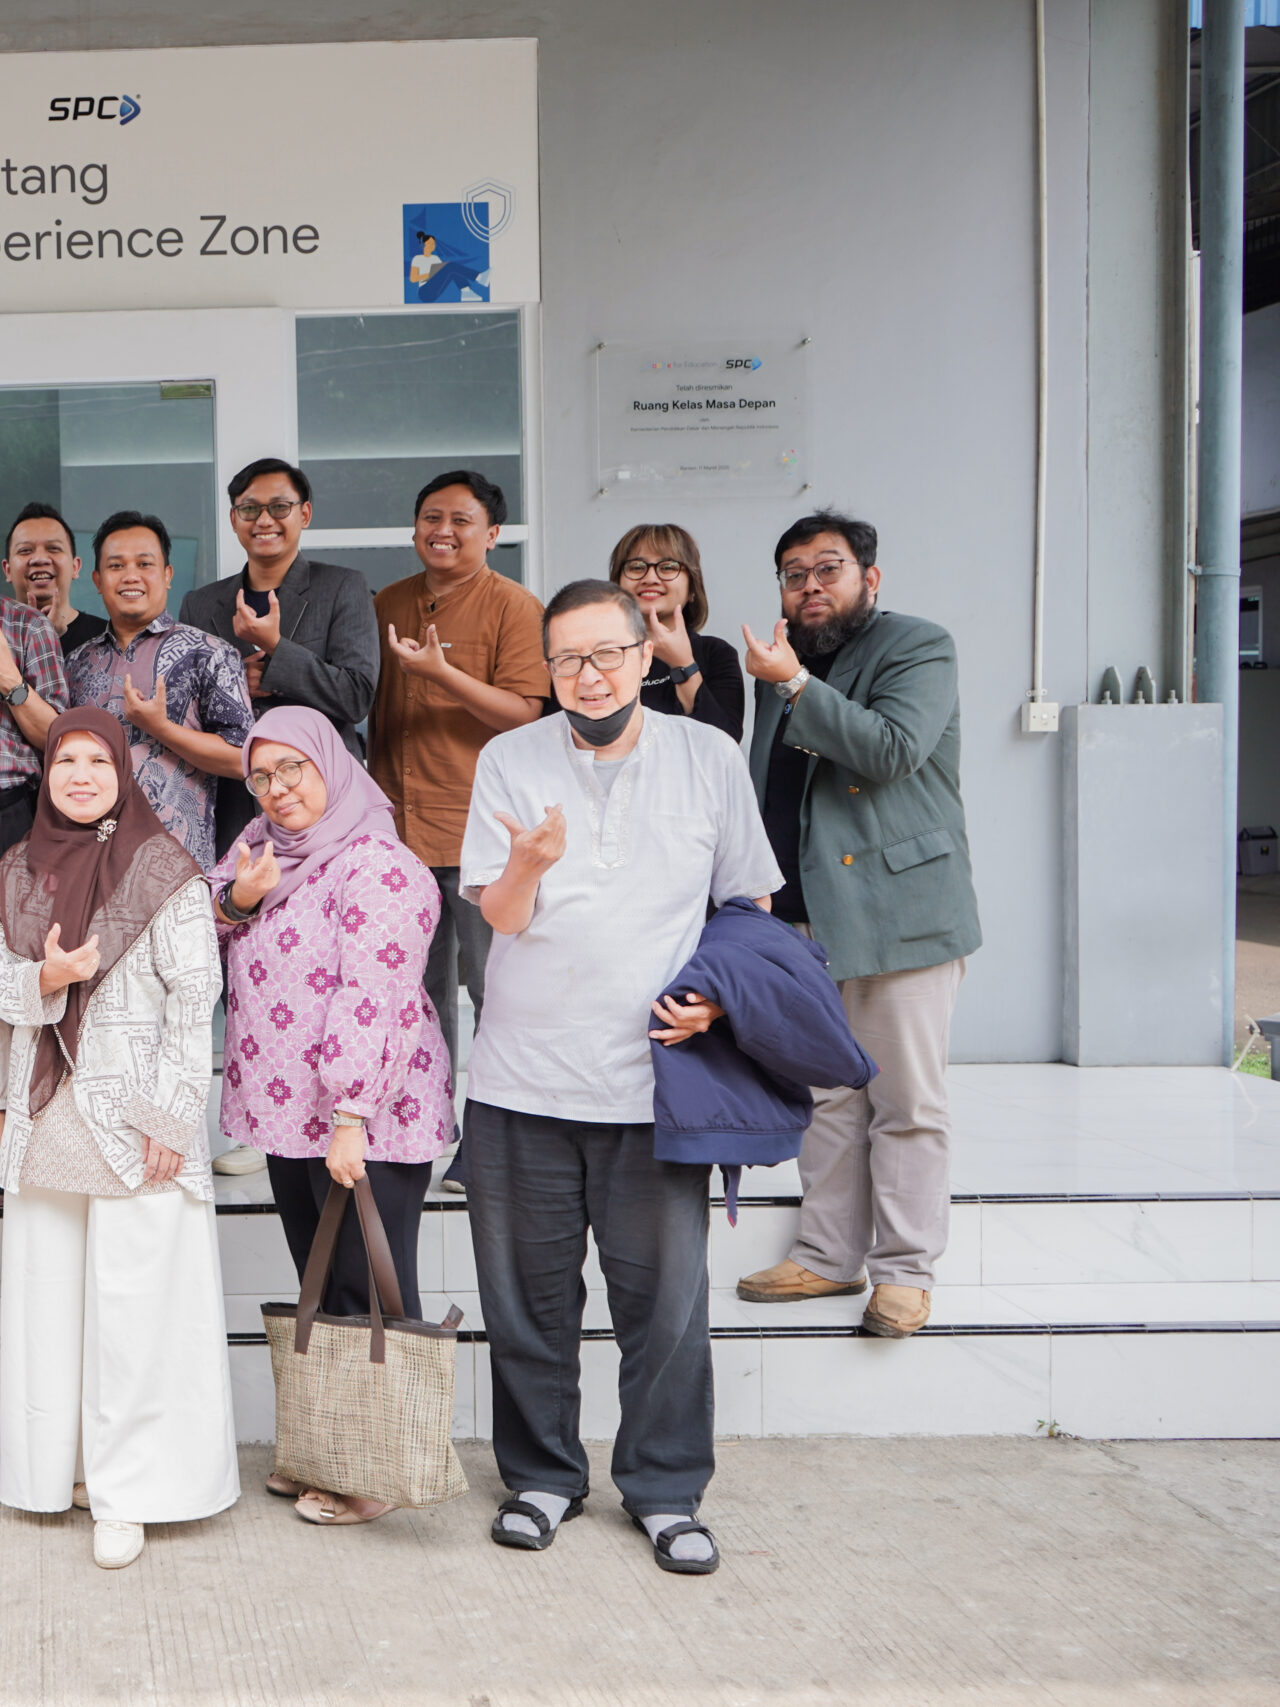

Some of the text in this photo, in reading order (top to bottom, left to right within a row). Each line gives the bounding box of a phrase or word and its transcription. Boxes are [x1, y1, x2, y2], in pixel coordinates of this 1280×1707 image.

[49, 96, 119, 121] SPC
[200, 215, 319, 256] Zone
[725, 359, 752, 370] SPC
[677, 384, 693, 392] Telah
[633, 398, 776, 413] Ruang Kelas Masa Depan
